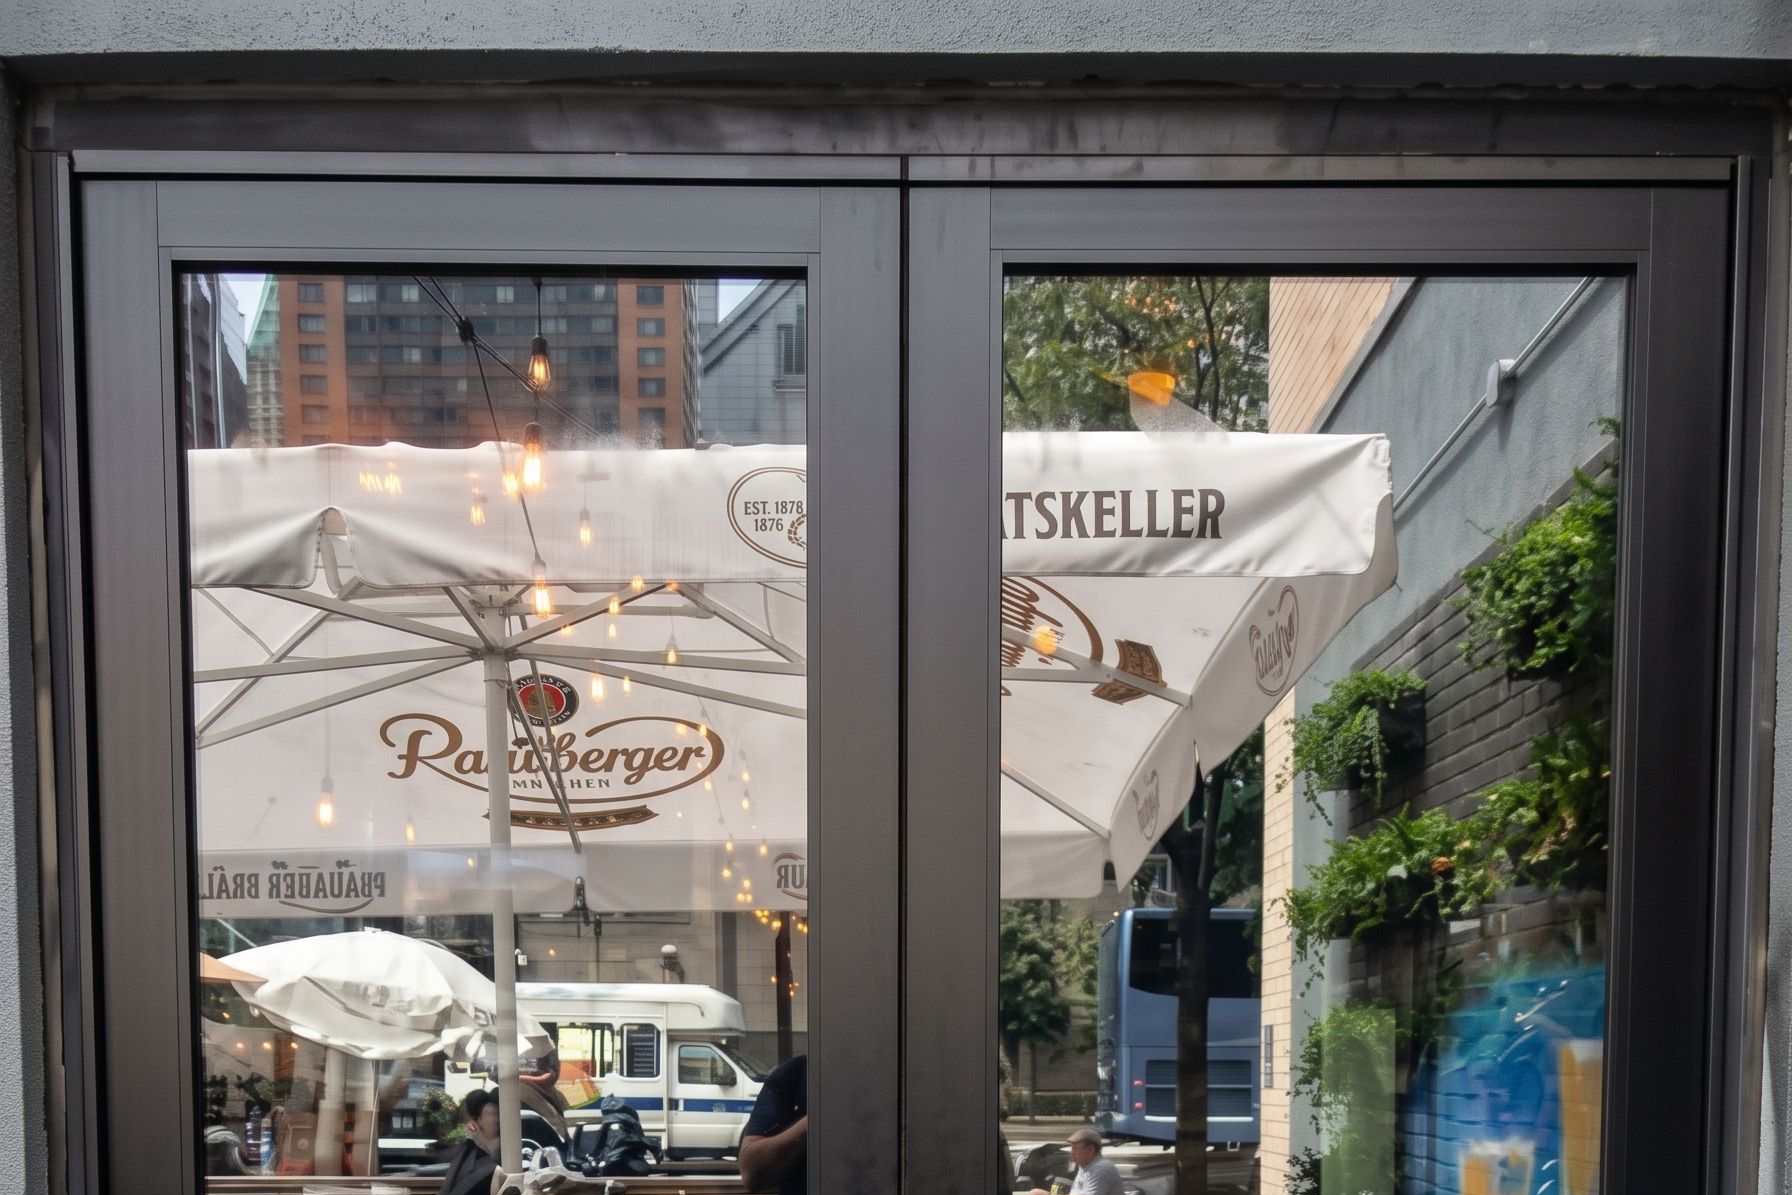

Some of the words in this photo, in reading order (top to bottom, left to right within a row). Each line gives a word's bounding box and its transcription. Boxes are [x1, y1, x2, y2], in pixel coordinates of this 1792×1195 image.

[744, 501, 771, 516] EST.
[775, 500, 804, 515] 1878
[1001, 488, 1225, 540] TSKELLER
[753, 518, 784, 532] 1876
